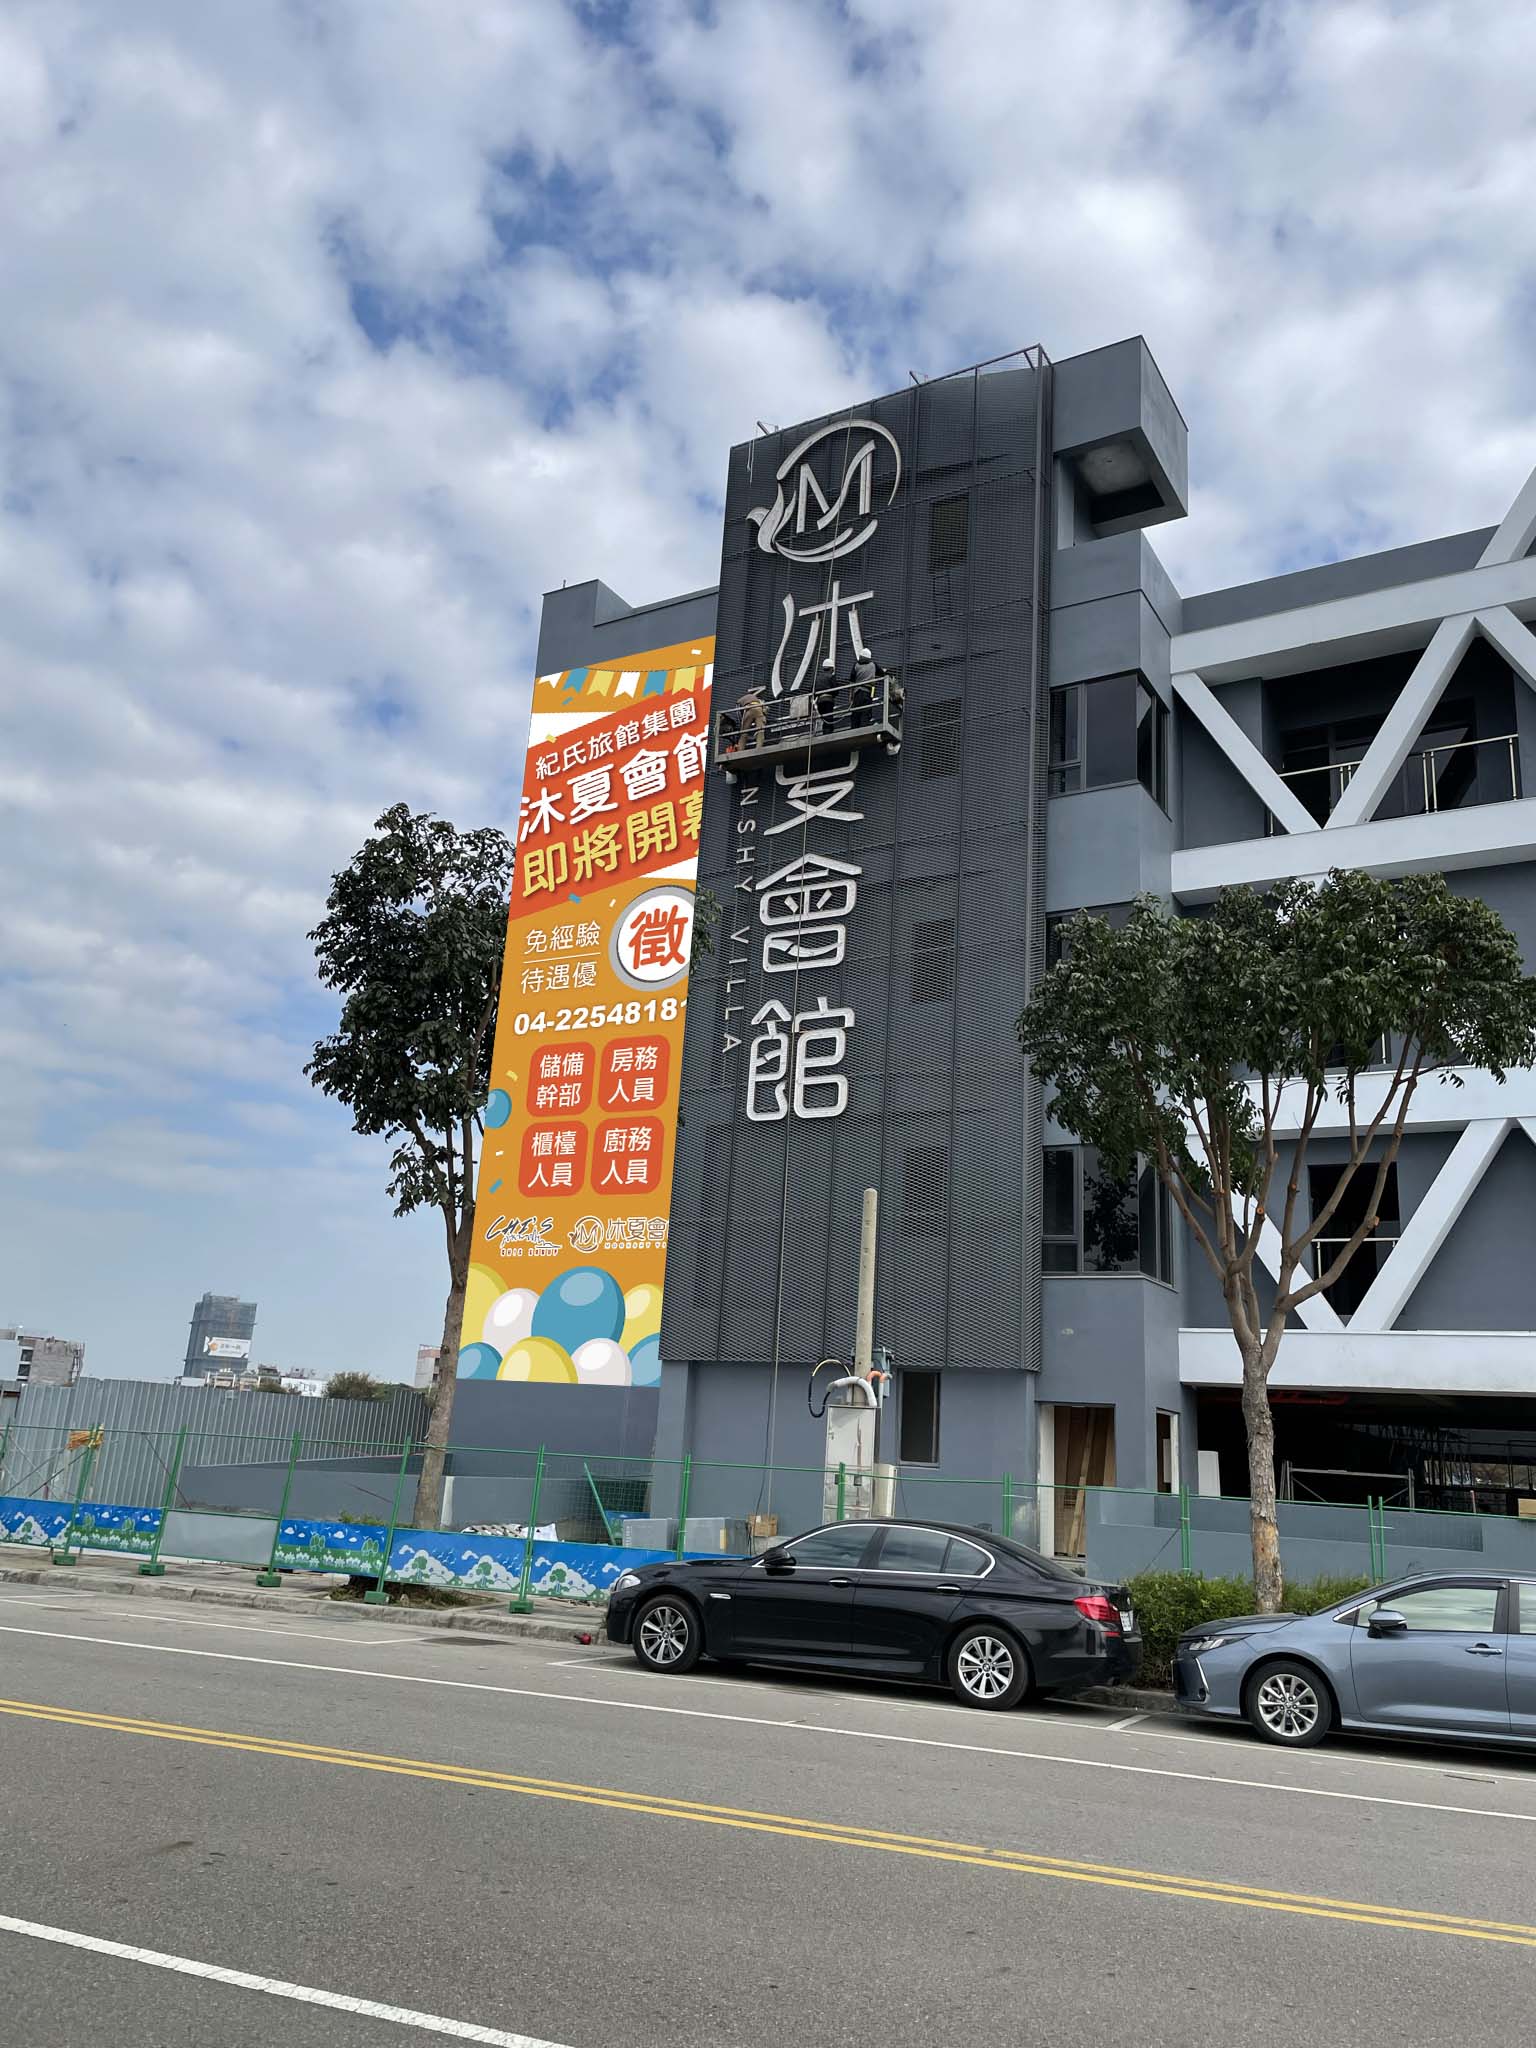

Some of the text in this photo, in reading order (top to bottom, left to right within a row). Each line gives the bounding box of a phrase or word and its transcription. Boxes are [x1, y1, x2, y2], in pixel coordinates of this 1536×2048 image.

[535, 697, 697, 780] 紀氏旅館集團
[523, 919, 601, 955] 免經驗
[628, 904, 689, 970] 徵
[520, 961, 598, 994] 待遇優
[722, 926, 750, 1053] VILLA
[513, 997, 688, 1036] 04-2254818
[539, 1051, 585, 1079] 儲備
[610, 1045, 659, 1073] 房務
[535, 1082, 583, 1109] 幹部
[607, 1077, 655, 1104] 人員
[603, 1126, 653, 1153] 廚務
[527, 1161, 573, 1188] 人員
[600, 1158, 649, 1185] 人員
